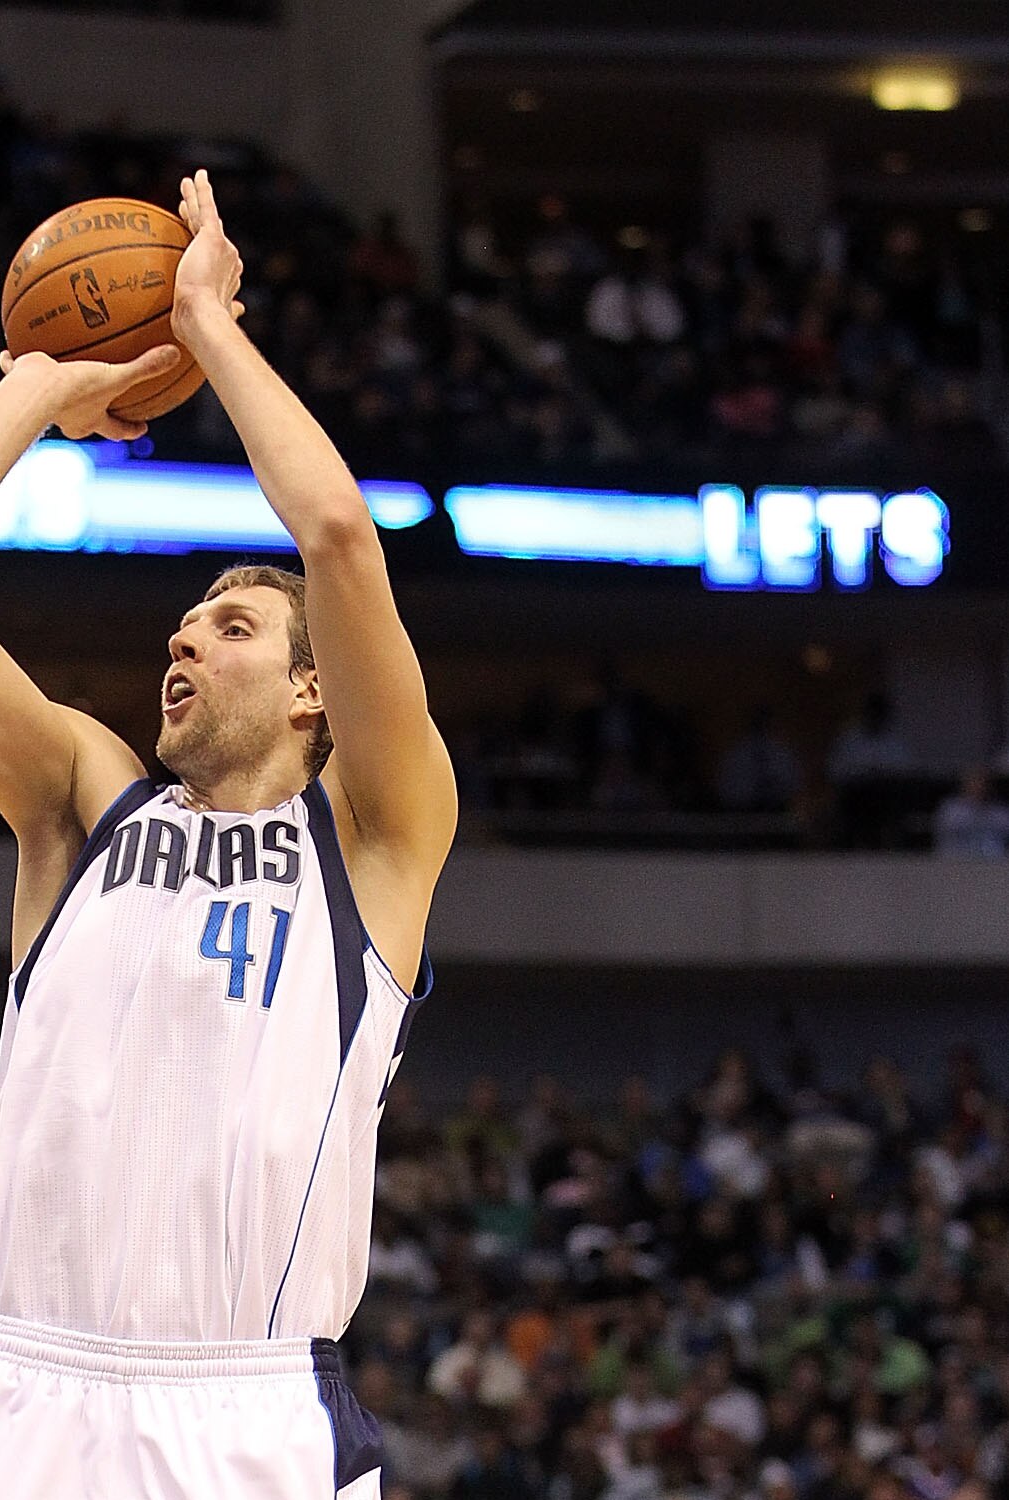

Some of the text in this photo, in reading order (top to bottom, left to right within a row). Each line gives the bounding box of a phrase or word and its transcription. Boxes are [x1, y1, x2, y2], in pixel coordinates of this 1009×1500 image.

[12, 211, 152, 288] SPALDING
[697, 484, 951, 594] LETS
[197, 899, 295, 1014] 41
